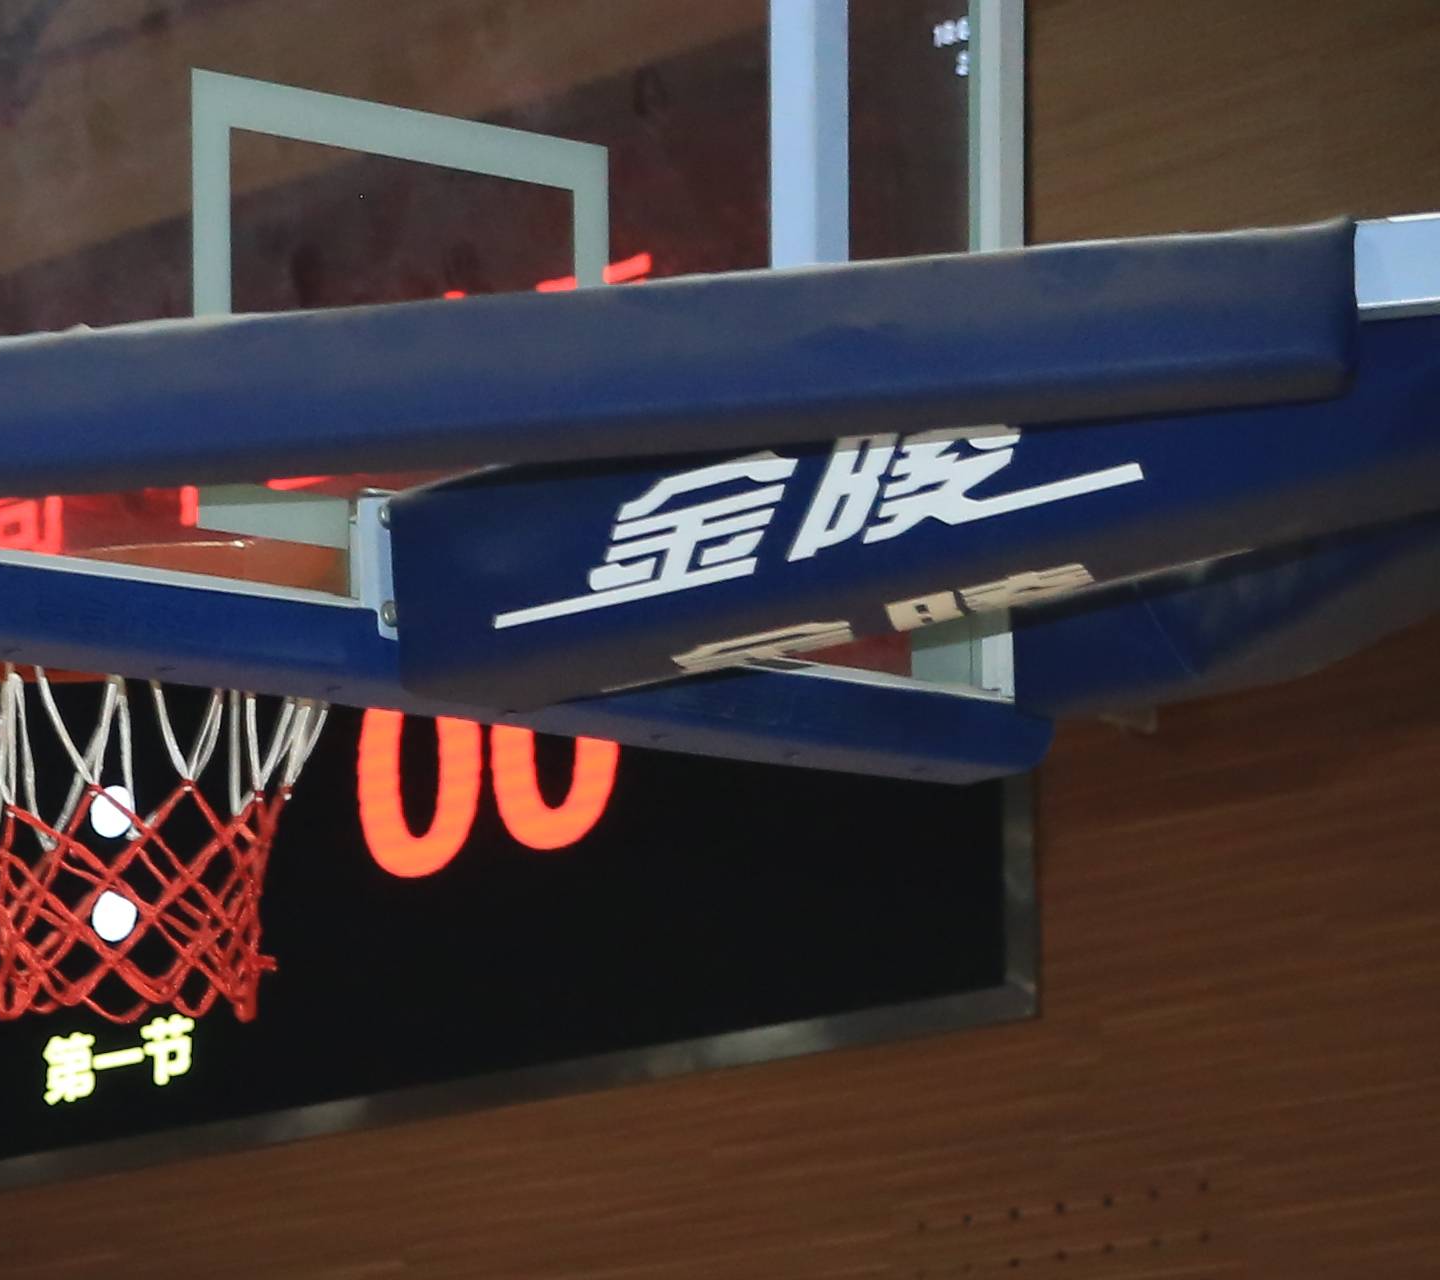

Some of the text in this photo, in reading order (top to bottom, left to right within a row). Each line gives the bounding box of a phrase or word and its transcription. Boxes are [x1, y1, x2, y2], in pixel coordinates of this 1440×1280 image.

[494, 424, 1143, 628] 金陵
[42, 1013, 196, 1106] 第一节
